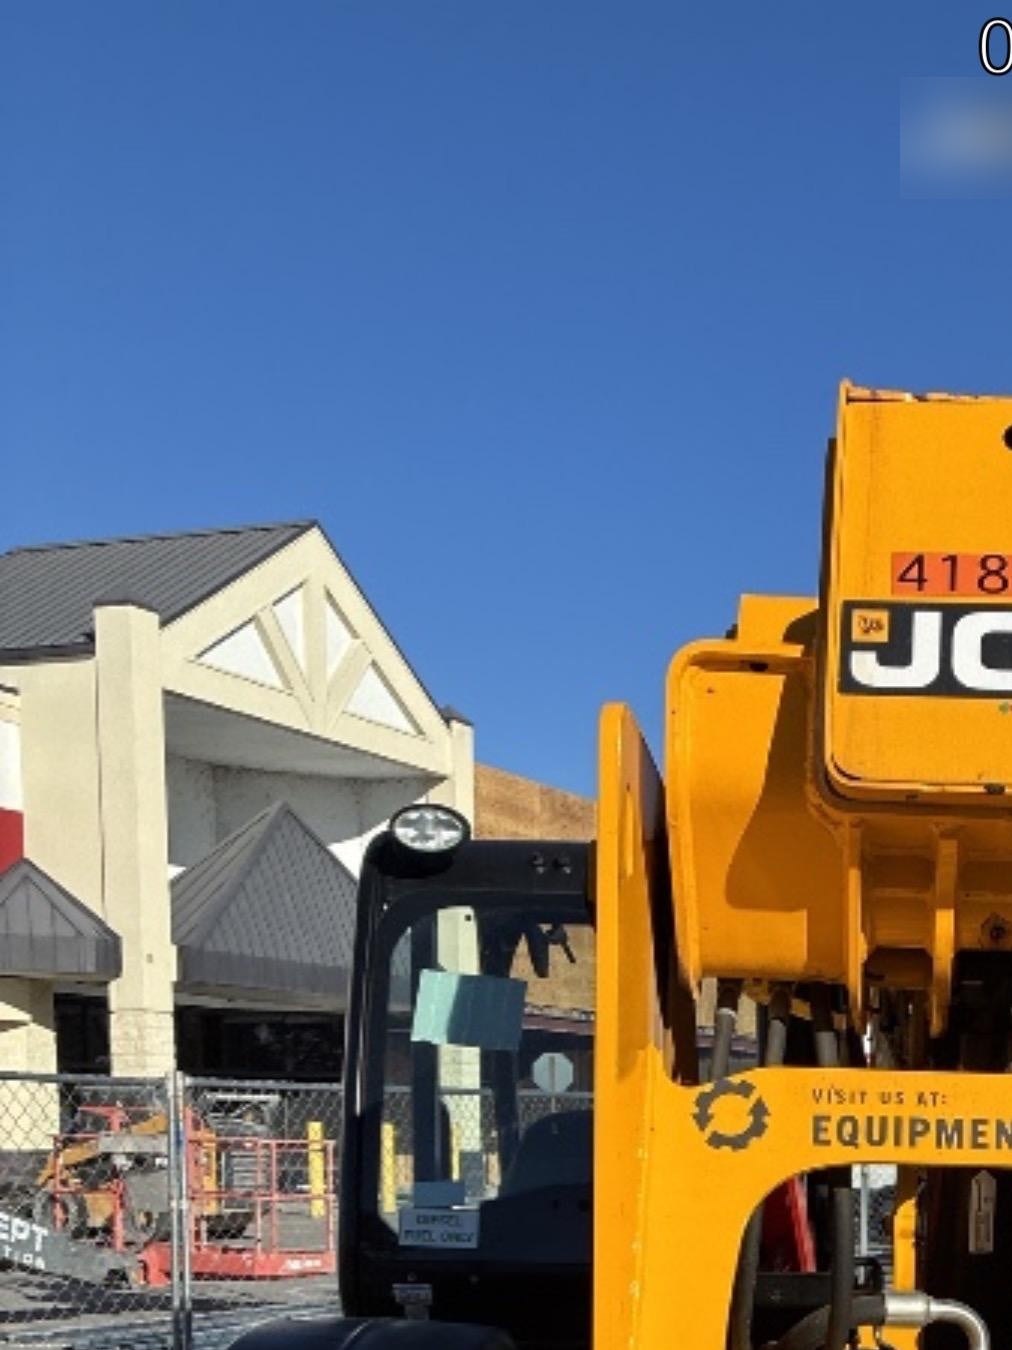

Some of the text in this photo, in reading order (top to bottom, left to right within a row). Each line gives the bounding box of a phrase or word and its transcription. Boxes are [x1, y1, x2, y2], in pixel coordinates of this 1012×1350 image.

[812, 1087, 949, 1108] VISIT US AT:
